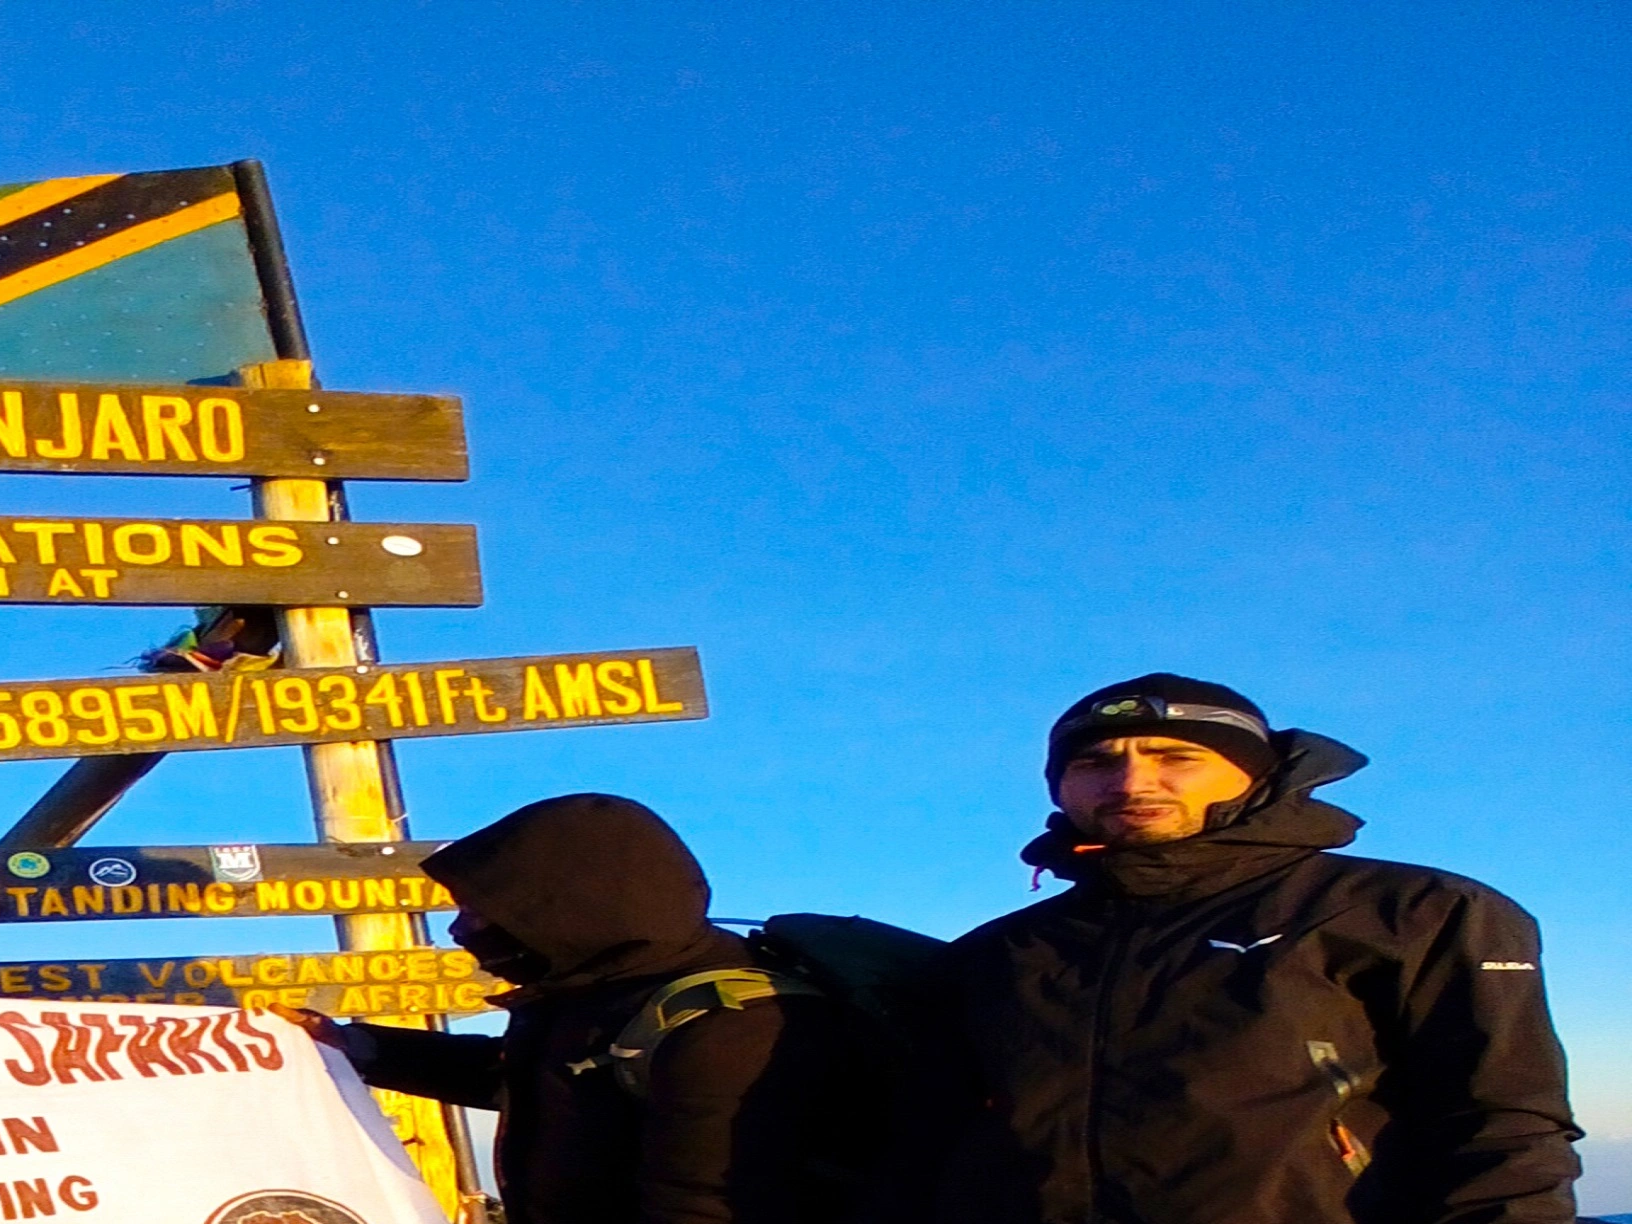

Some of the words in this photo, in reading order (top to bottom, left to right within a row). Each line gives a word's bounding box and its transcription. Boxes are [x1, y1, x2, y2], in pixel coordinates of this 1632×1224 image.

[48, 569, 119, 599] AT
[524, 659, 683, 720] AMSL
[256, 876, 454, 913] MOUNTA
[140, 950, 474, 988] VOLCANOES
